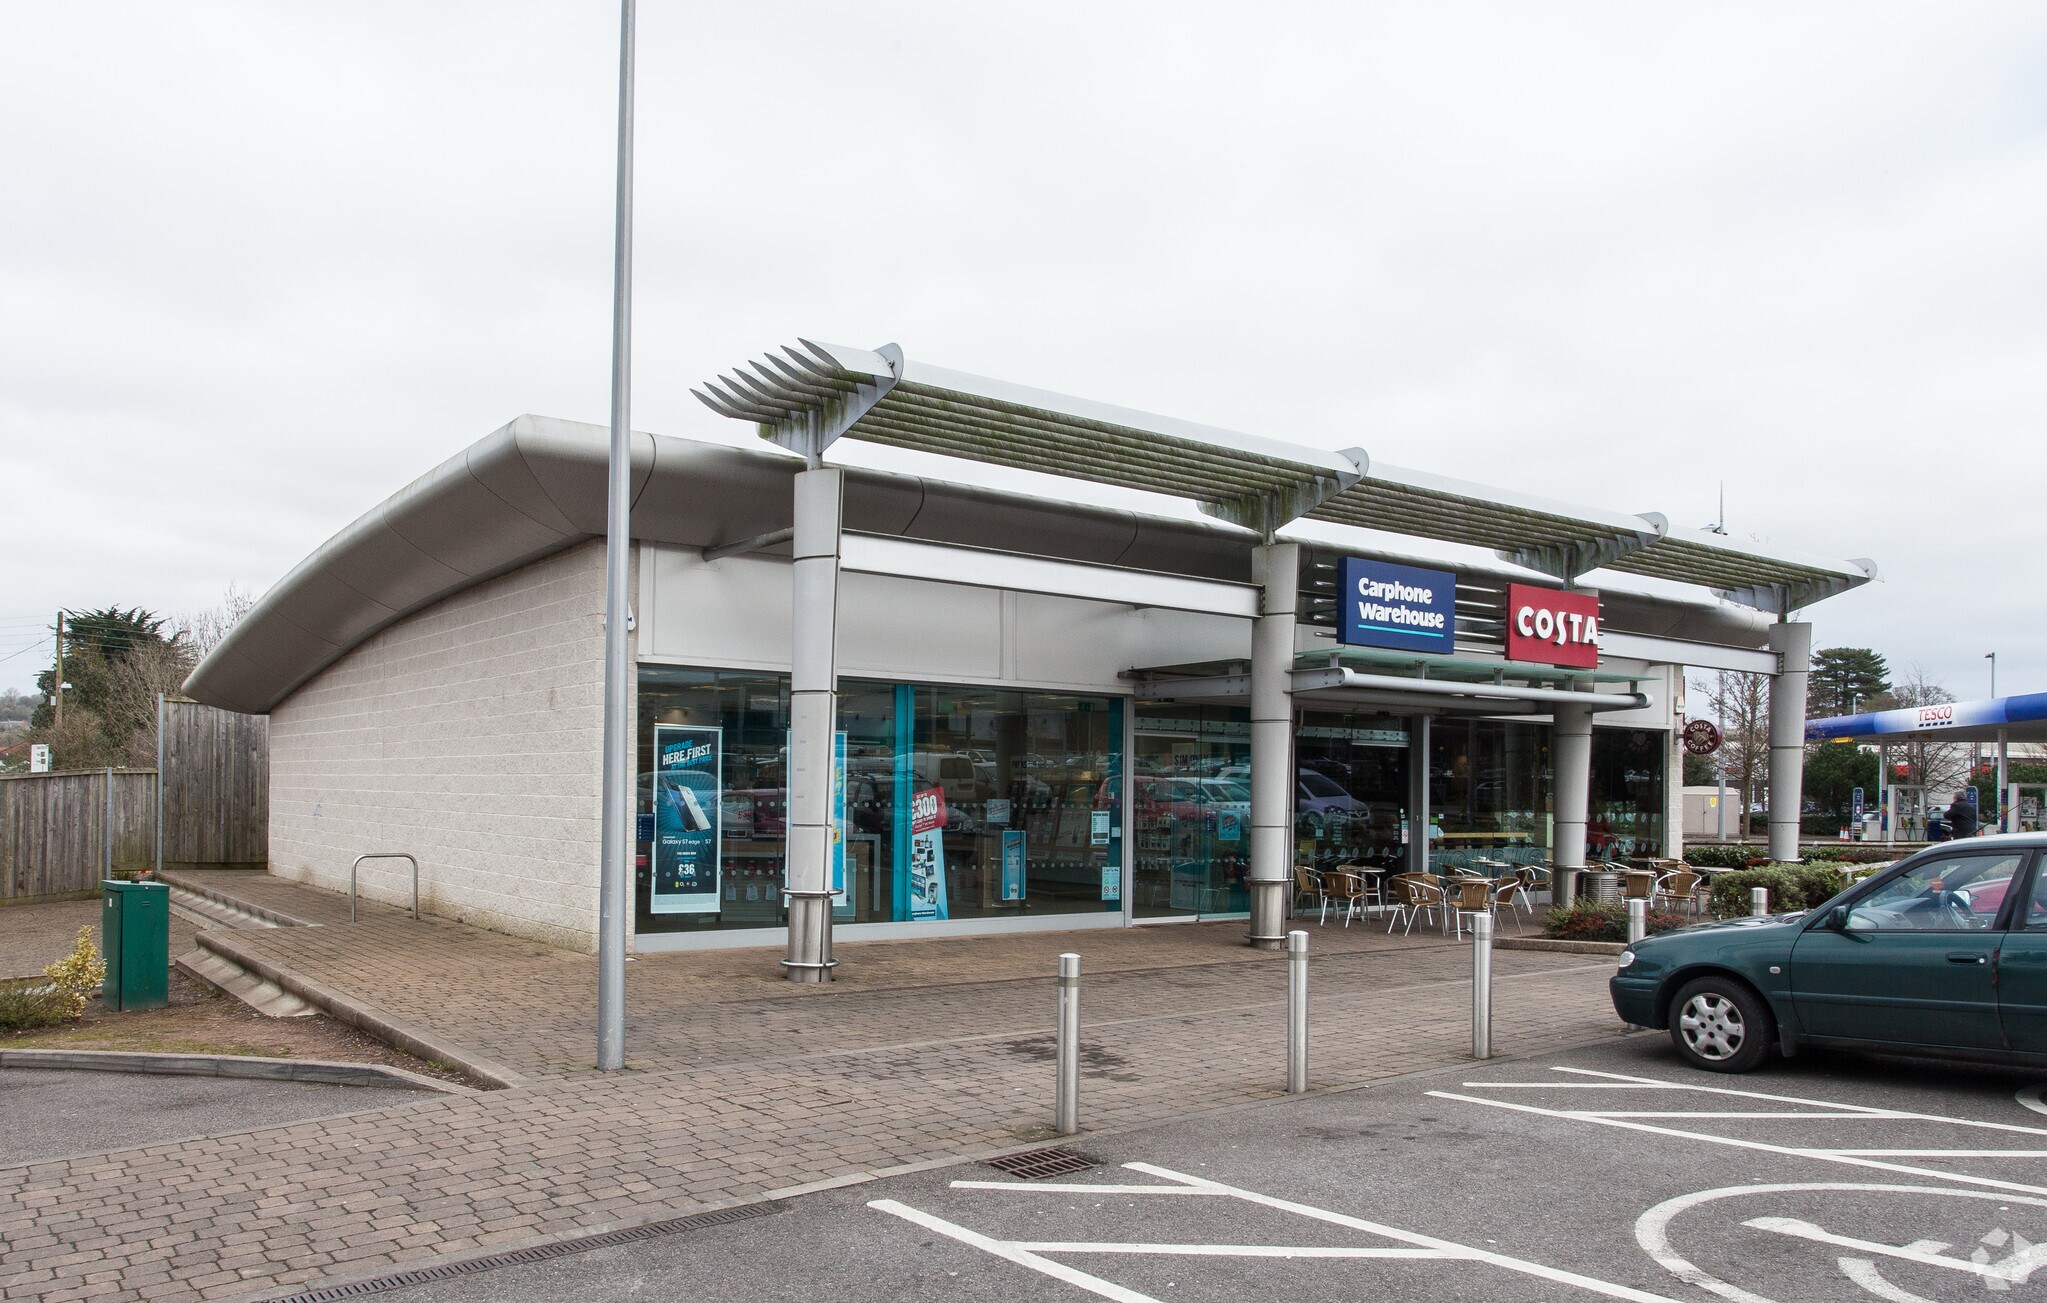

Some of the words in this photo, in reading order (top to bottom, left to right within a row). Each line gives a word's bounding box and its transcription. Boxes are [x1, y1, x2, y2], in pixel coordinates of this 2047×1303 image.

[1358, 577, 1433, 605] Carphone
[1358, 601, 1445, 629] Warehouse
[1515, 605, 1598, 646] COSTA
[1918, 705, 1953, 722] TESCO
[1690, 723, 1711, 732] COSTA
[664, 739, 693, 754] UPGRADE
[1687, 739, 1714, 752] COFFEE
[662, 750, 685, 766] HERE
[687, 743, 712, 760] FIRST
[678, 863, 695, 875] £36
